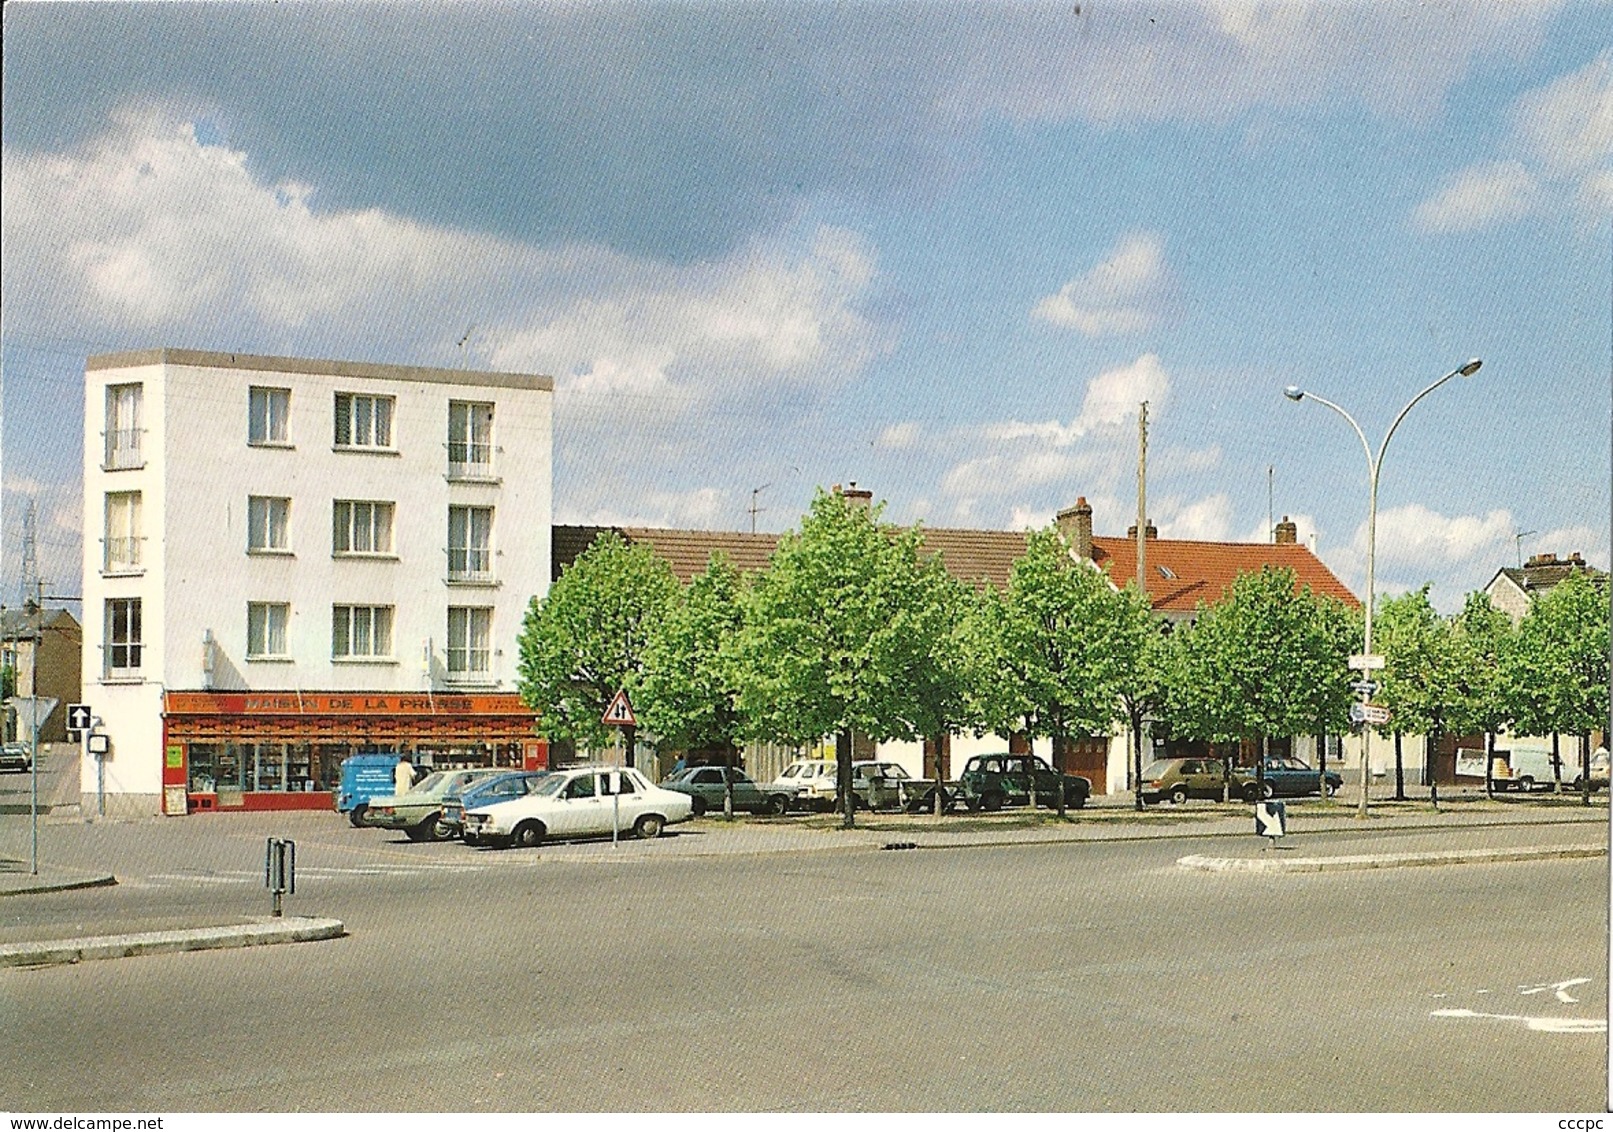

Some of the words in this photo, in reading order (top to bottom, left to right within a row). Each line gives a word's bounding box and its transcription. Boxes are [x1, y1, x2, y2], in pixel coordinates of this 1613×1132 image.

[244, 697, 318, 710] MAISON
[329, 698, 353, 710] DE
[364, 698, 389, 710] LA
[399, 698, 473, 710] PRESSE
